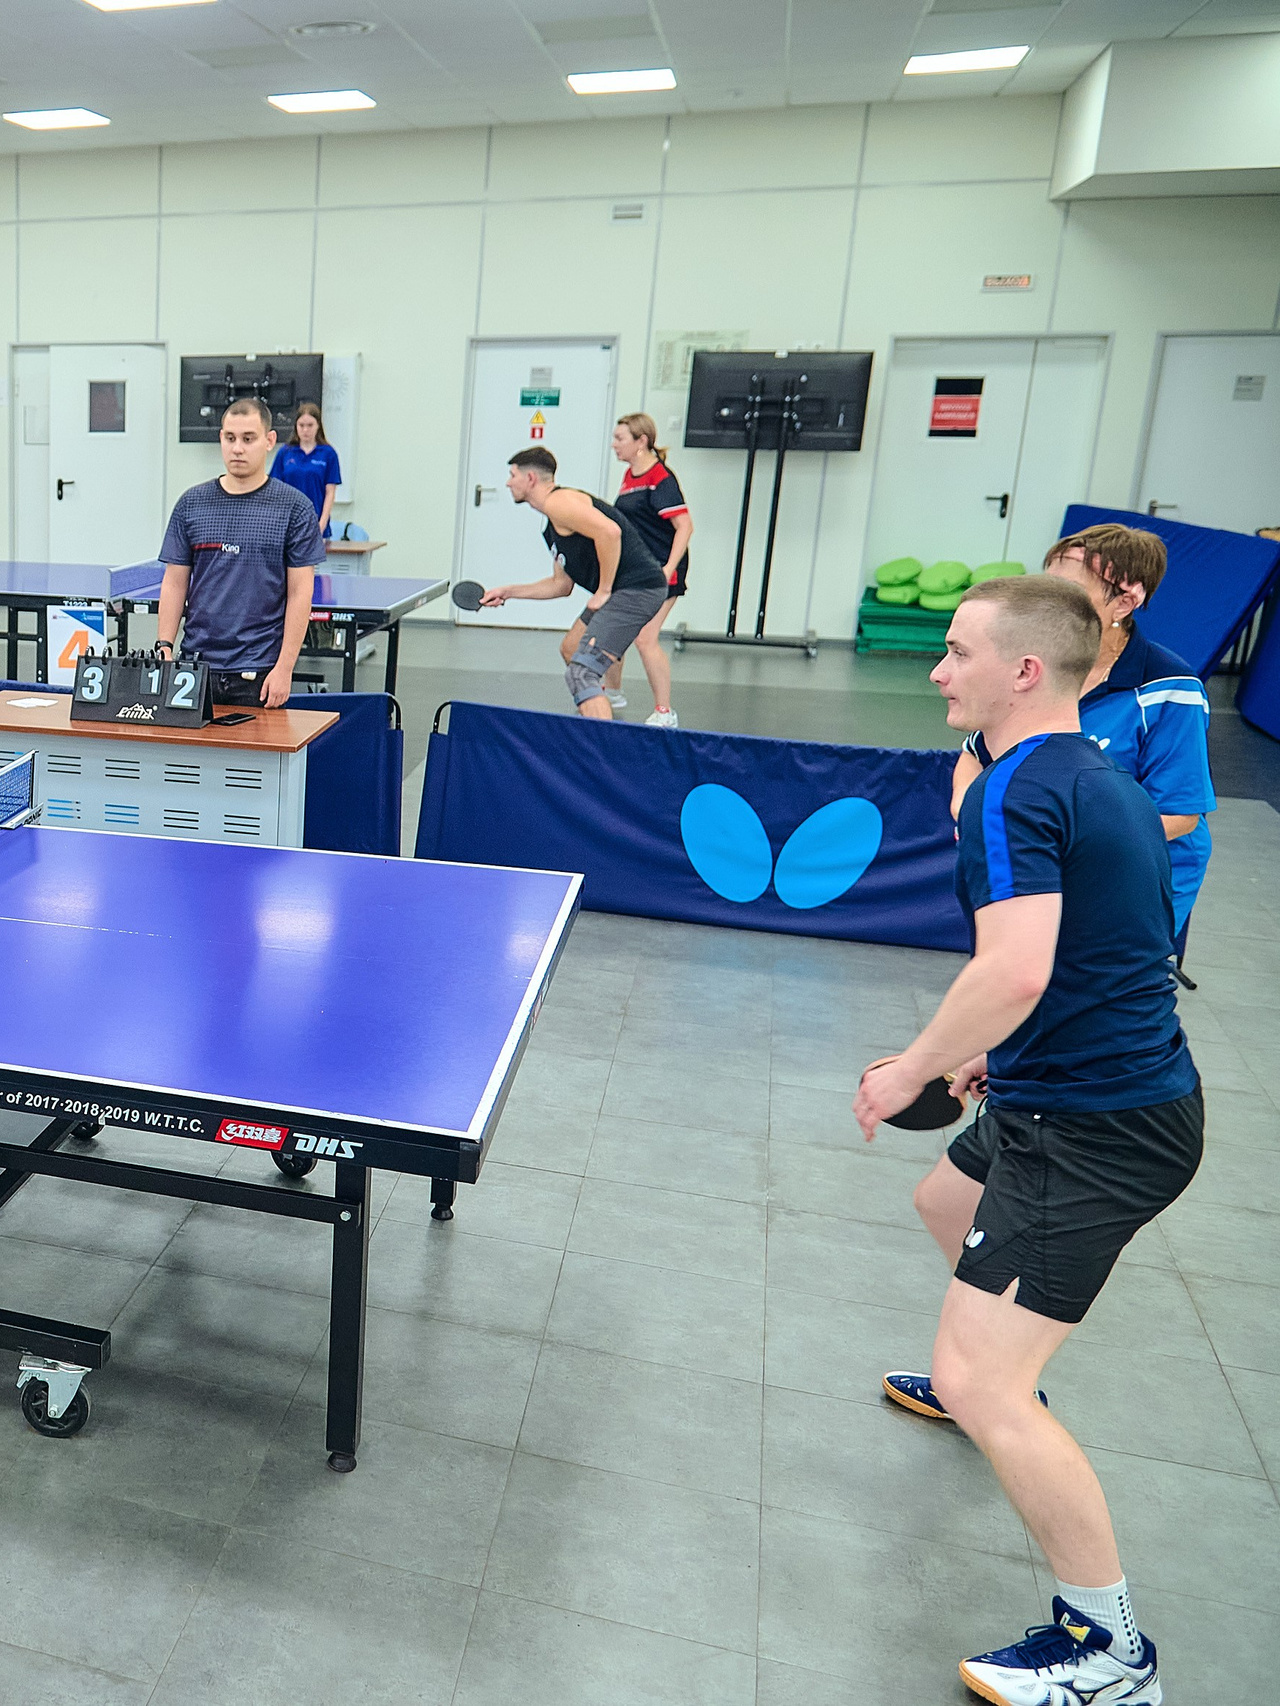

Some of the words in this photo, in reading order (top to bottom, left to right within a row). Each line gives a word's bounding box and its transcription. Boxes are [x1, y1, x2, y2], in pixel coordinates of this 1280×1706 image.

[58, 630, 89, 668] 4
[81, 666, 104, 700] 3
[148, 669, 160, 694] 1
[170, 671, 196, 707] 2
[6, 1092, 23, 1104] of
[144, 1111, 205, 1133] W.T.T.C.
[221, 1123, 282, 1144] 红双喜
[292, 1132, 364, 1159] DHS
